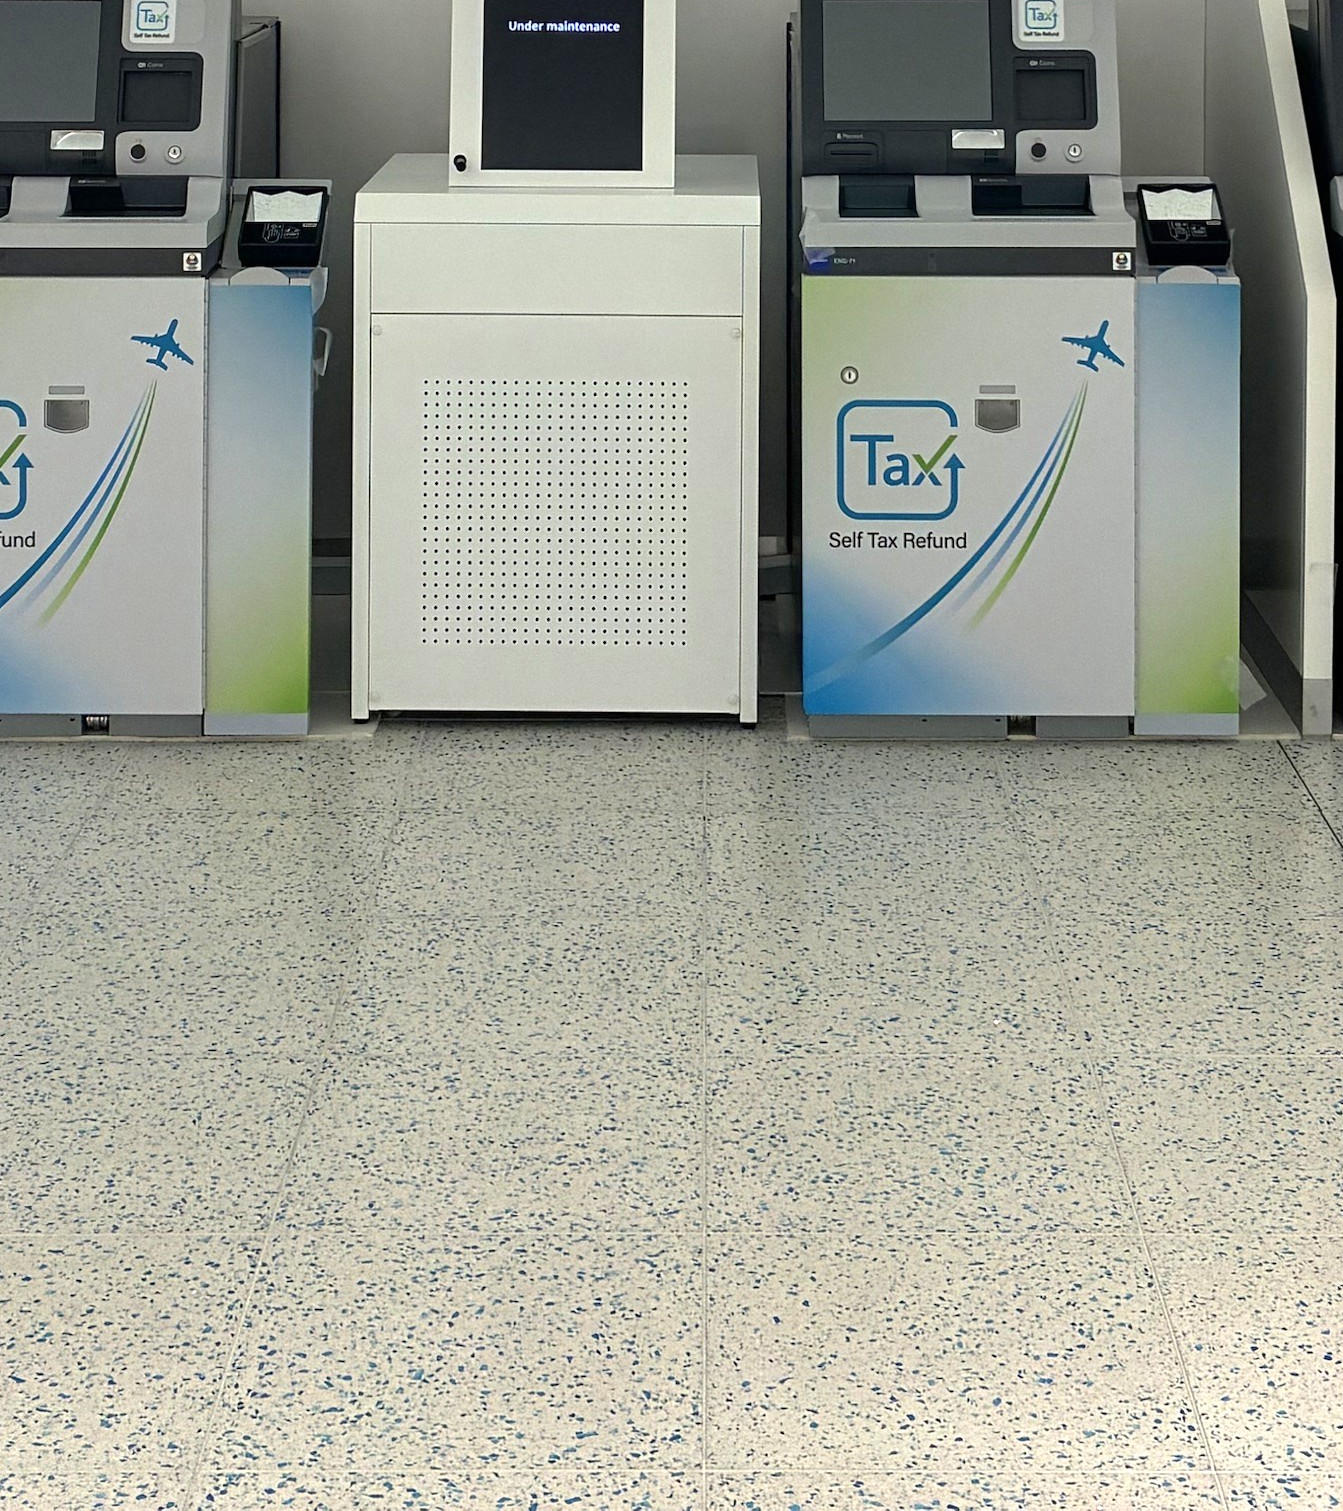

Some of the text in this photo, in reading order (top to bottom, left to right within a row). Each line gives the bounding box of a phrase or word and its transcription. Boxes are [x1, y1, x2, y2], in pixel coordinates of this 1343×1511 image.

[140, 8, 168, 24] Tax
[1028, 6, 1056, 22] Tax
[508, 20, 621, 32] Under maintenance
[850, 434, 958, 486] Tax
[829, 531, 967, 549] Self Tax Refund
